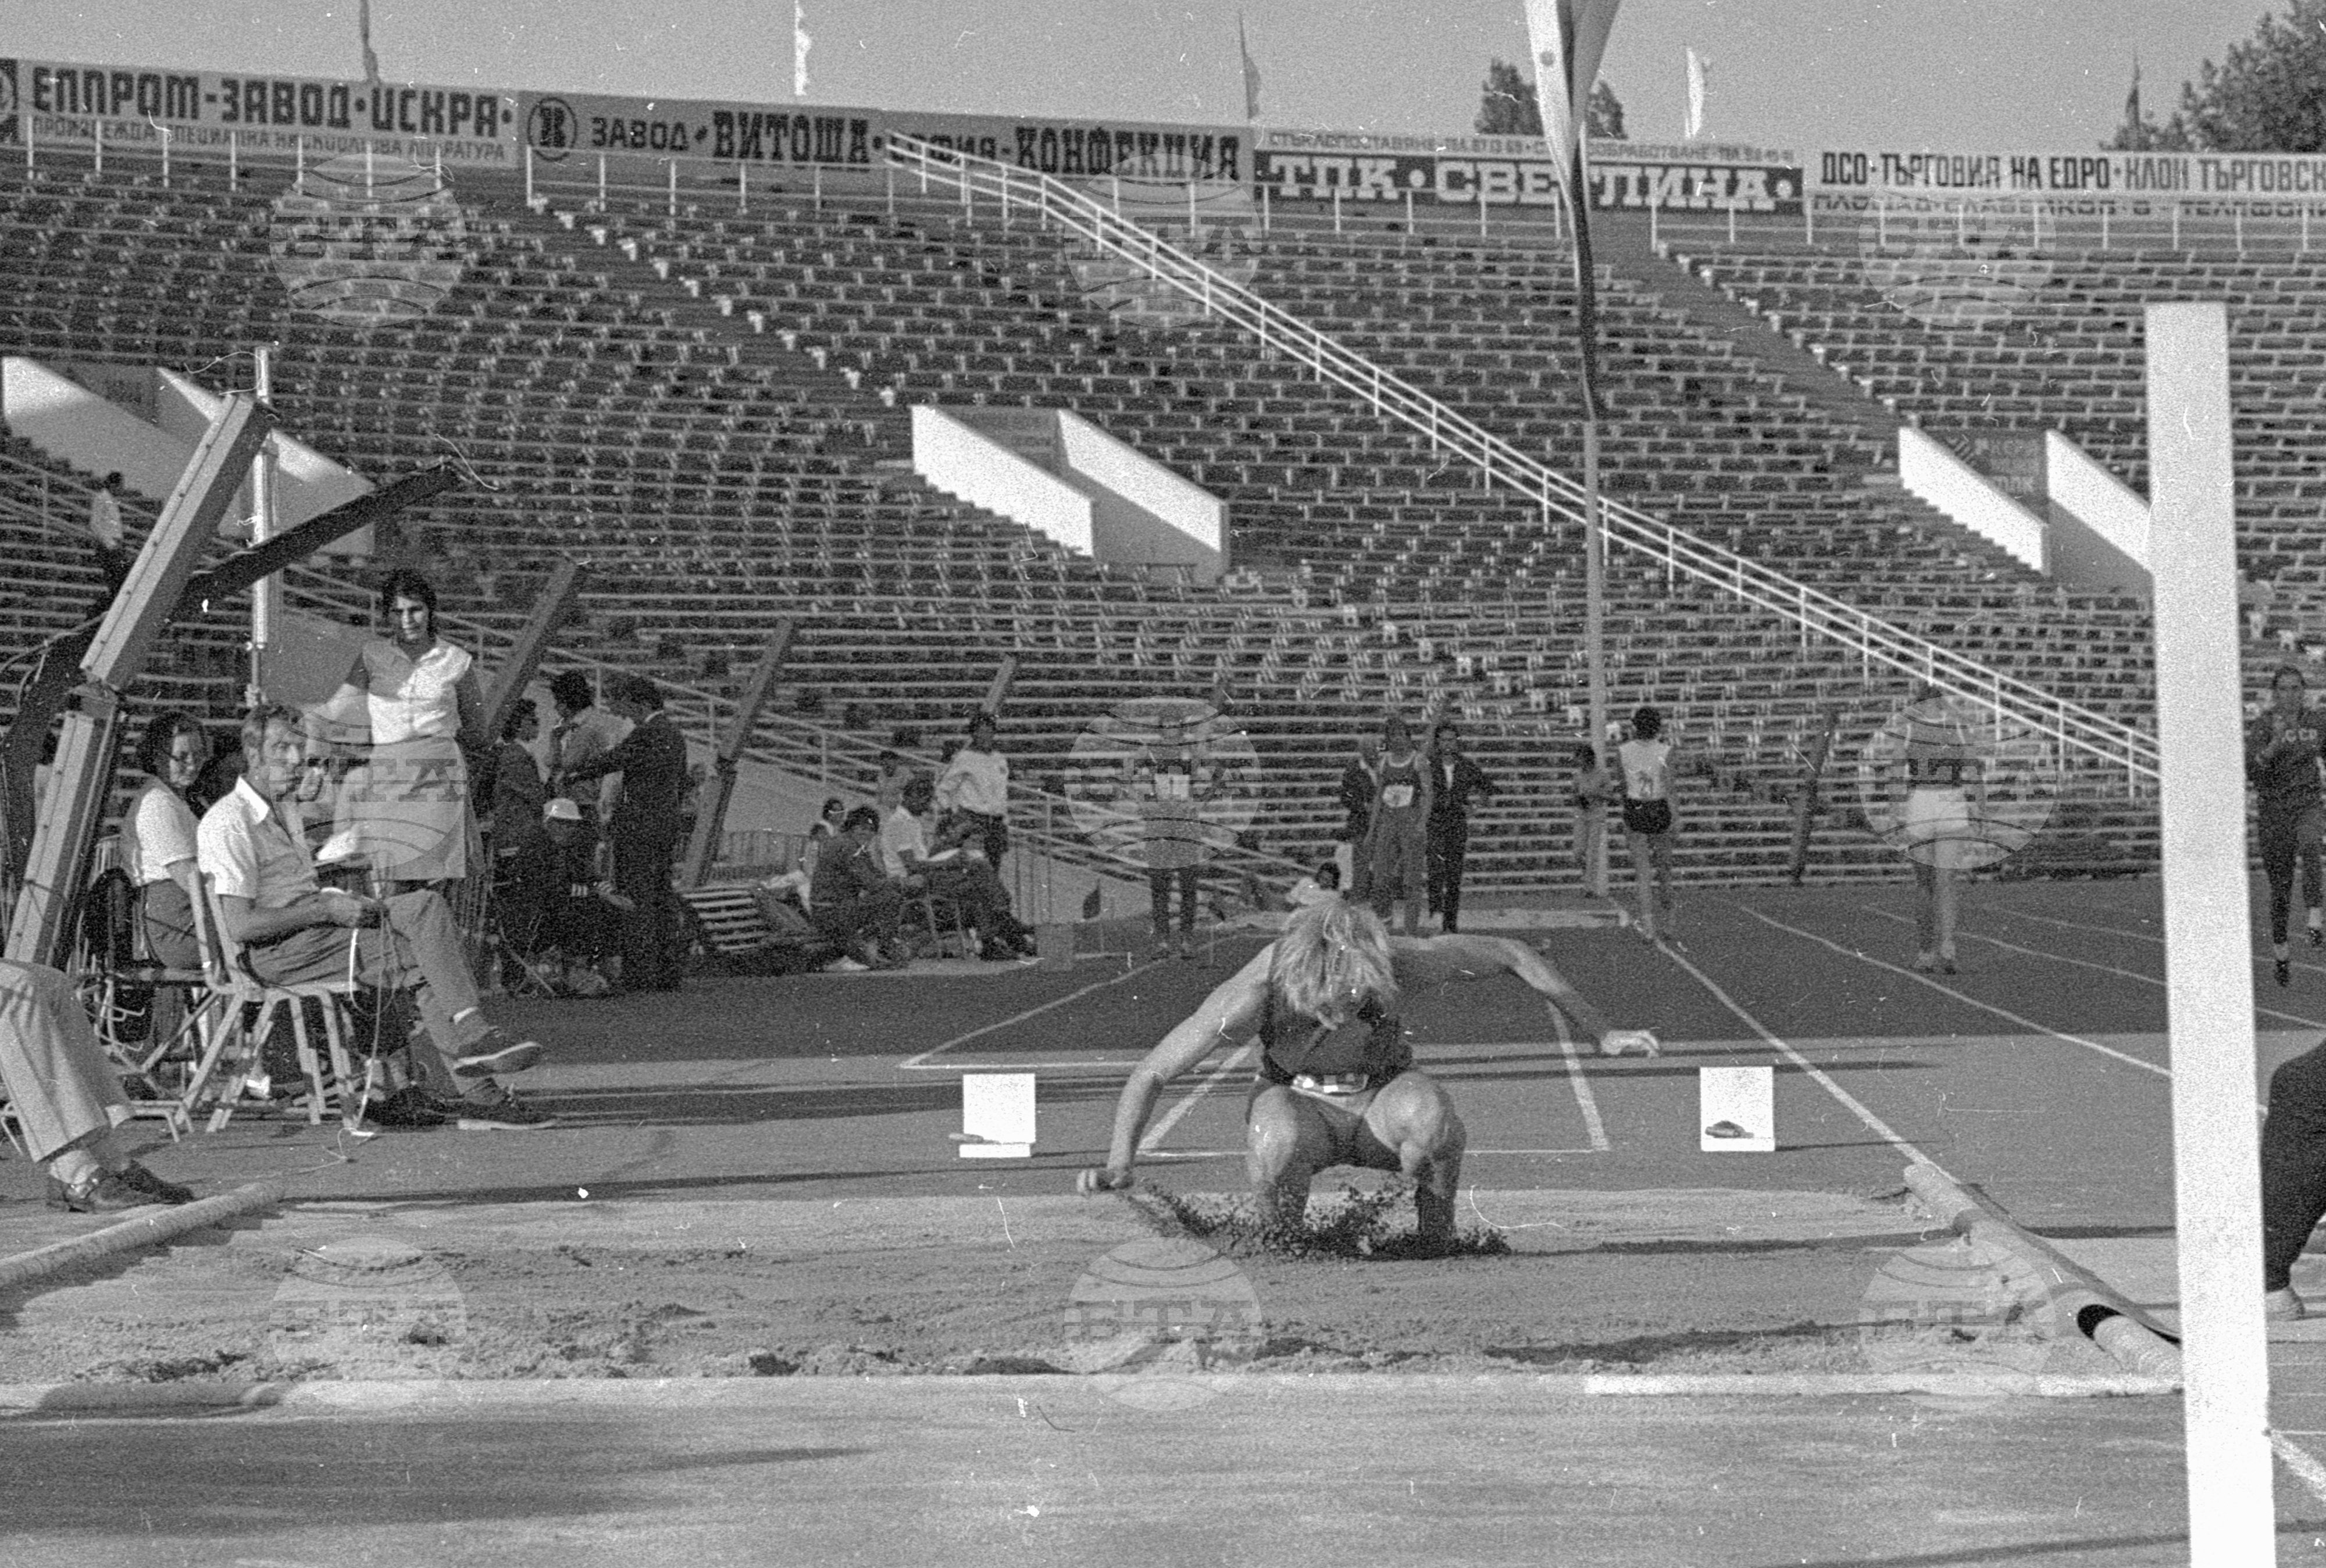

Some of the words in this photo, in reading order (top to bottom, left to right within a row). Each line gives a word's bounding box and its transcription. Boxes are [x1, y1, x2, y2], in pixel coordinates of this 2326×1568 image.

[370, 87, 498, 137] ИСКРА
[592, 117, 689, 150] ЗАВОД
[713, 111, 869, 163] ВИТОША
[1015, 126, 1239, 180] КОНФЕКЦИЯ
[1822, 152, 1867, 185] ДСО
[2011, 157, 2041, 191] НА
[2050, 157, 2109, 190] ЕДРО
[2126, 158, 2188, 191] КЛОН
[1268, 155, 1398, 201] ТПК
[1435, 159, 1776, 214] СВЕЛИНА
